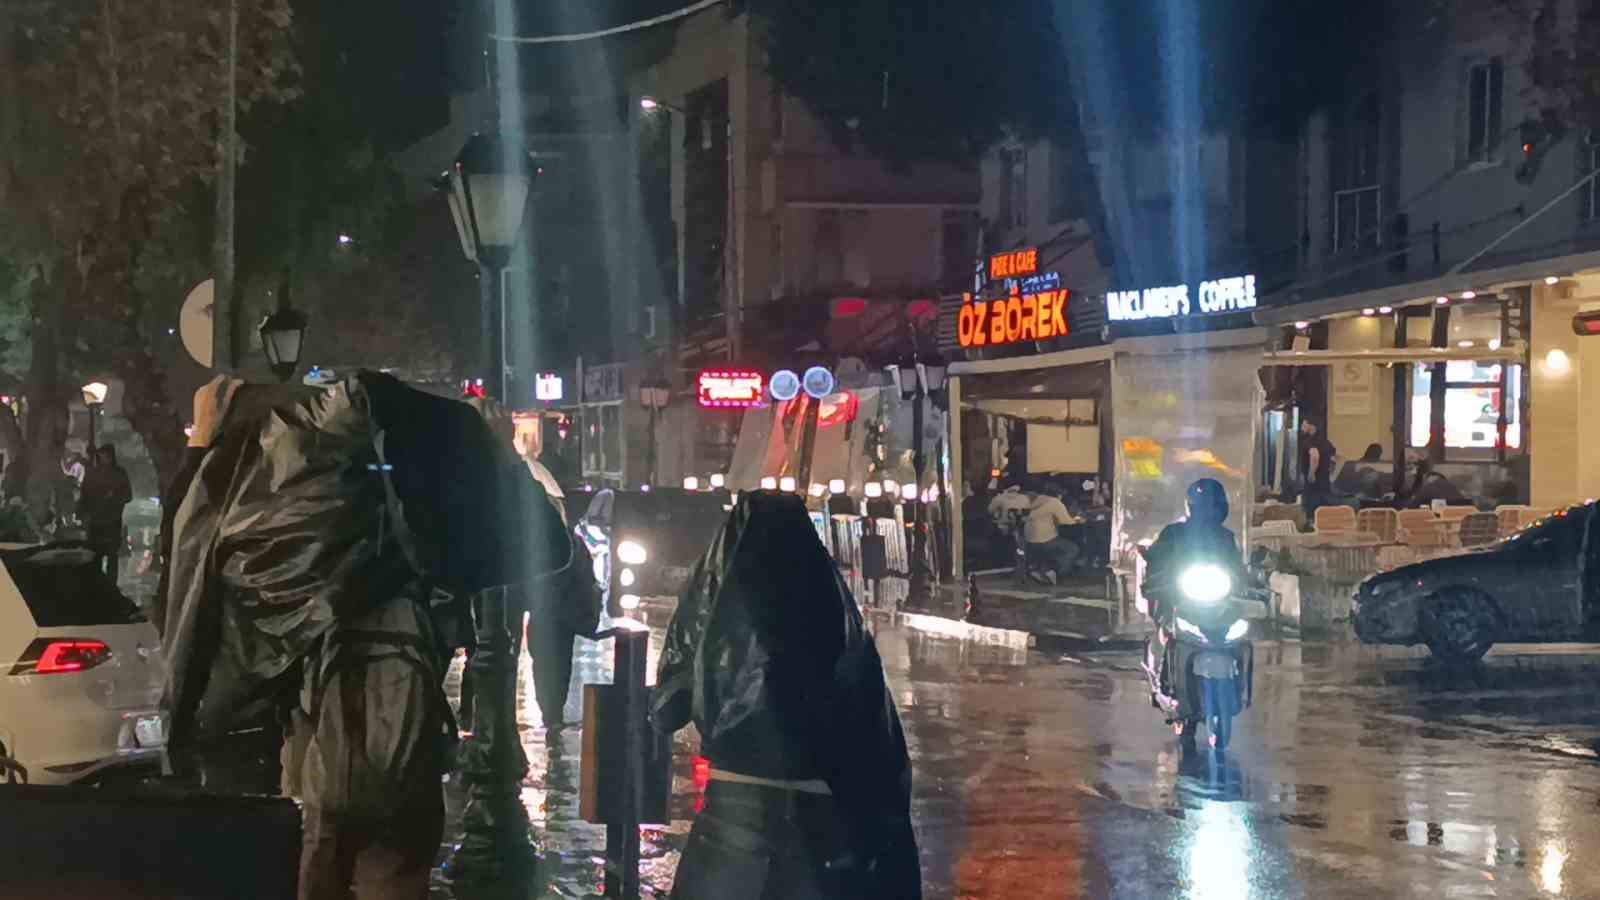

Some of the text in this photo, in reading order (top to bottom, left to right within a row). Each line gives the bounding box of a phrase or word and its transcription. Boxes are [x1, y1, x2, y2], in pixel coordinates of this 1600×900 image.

[959, 287, 1068, 346] ÖZ BÖREK
[1199, 274, 1256, 312] COFFEE
